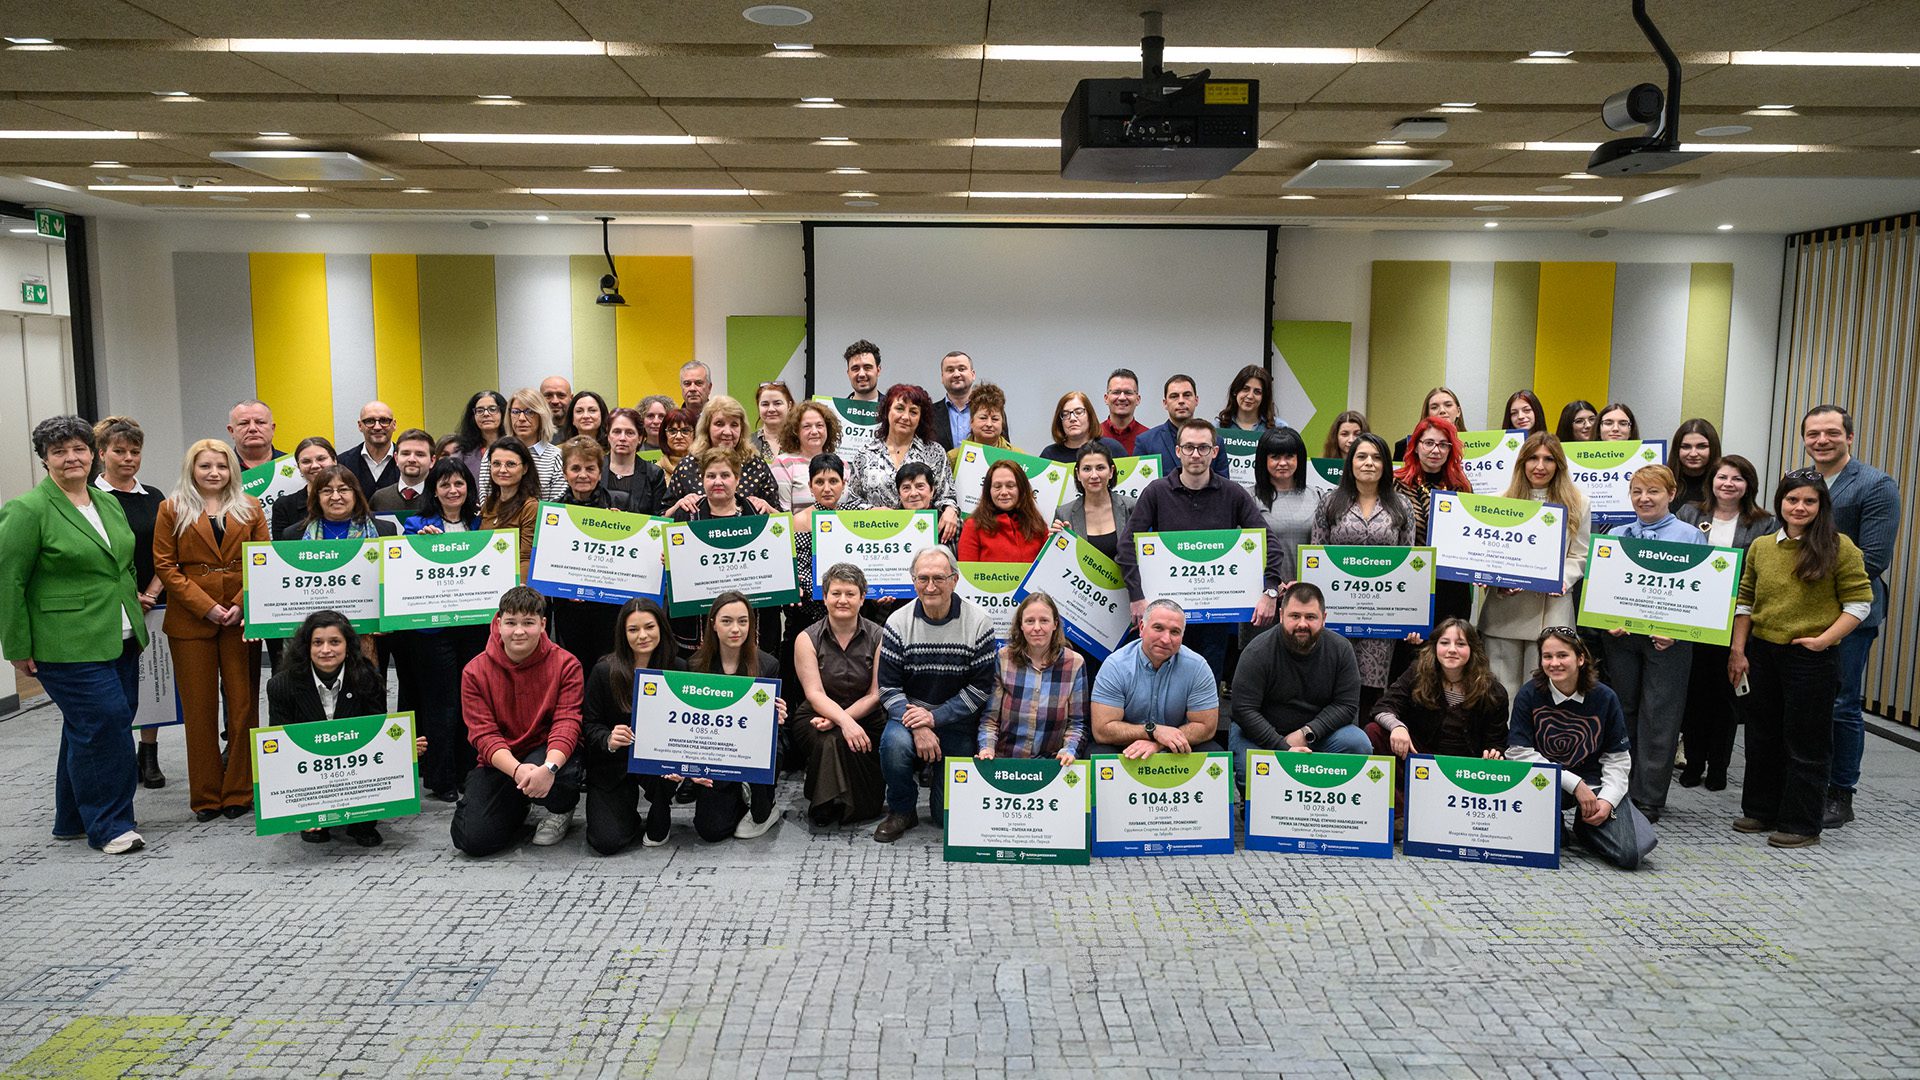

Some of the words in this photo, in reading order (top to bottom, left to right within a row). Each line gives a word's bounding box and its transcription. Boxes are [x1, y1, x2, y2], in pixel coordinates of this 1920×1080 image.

[847, 407, 879, 417] #BeLoca
[1576, 451, 1624, 459] #BeActive
[1228, 458, 1256, 469] 70.9
[1496, 460, 1504, 470] €
[1573, 471, 1619, 483] 766.94
[1623, 471, 1632, 481] €
[1474, 505, 1524, 518] #BeActive
[581, 518, 631, 532] #BeActive
[853, 520, 899, 528] #BeActive
[708, 526, 752, 538] #BeLocal
[1463, 526, 1470, 537] 2
[1475, 528, 1523, 543] 454.20
[1527, 534, 1537, 545] €
[431, 542, 470, 552] #BeFair
[571, 540, 580, 551] 3
[583, 542, 625, 557] 175.12
[629, 548, 639, 559] €
[845, 543, 853, 554] 6
[856, 543, 899, 554] 435.63
[903, 542, 912, 553] €
[1177, 541, 1224, 551] #BeGreen
[298, 551, 339, 560] #BeFair
[700, 555, 709, 566] 6
[712, 550, 756, 565] 237.76
[760, 549, 769, 560] €
[1342, 557, 1392, 566] #BeGreen
[1638, 549, 1690, 563] #BeVocal
[416, 569, 423, 580] 5
[428, 565, 477, 579] 884.97
[481, 565, 490, 576] €
[1083, 555, 1119, 585] #BeActive
[1170, 566, 1177, 577] 2
[1182, 564, 1225, 577] 224.12
[1229, 564, 1238, 575] €
[282, 577, 290, 589] 5
[295, 575, 346, 588] 879.86
[351, 574, 361, 585] €
[974, 573, 1019, 581] #BeActive
[1624, 573, 1633, 584] 3
[1637, 574, 1685, 590] 221.14
[1690, 580, 1701, 592] €
[1062, 568, 1072, 579] 7
[1070, 575, 1108, 606] 203.08
[1108, 603, 1118, 613] €
[1331, 581, 1339, 591] 6
[1344, 581, 1392, 592] 749.05
[1397, 581, 1406, 592] €
[682, 685, 733, 697] #BeGreen
[668, 711, 677, 723] 2
[682, 712, 733, 728] 088.63
[738, 717, 748, 729] €
[314, 730, 359, 744] #BeFair
[297, 761, 307, 774] 6
[313, 753, 368, 772] 881.99
[373, 751, 384, 764] €
[329, 771, 345, 779] 460
[994, 770, 1043, 781] #BeLocal
[1138, 765, 1189, 775] #BeActive
[1295, 764, 1347, 775] #BeGreen
[1455, 769, 1511, 782] #BeGreen
[982, 797, 990, 809] 5
[995, 798, 1044, 810] 376.23
[1048, 799, 1058, 811] €
[1128, 793, 1137, 805] 6
[1142, 792, 1189, 804] 104.83
[1194, 791, 1203, 803] €
[1284, 790, 1292, 801] 5
[1297, 791, 1346, 804] 152.80
[1351, 793, 1361, 805] €
[1448, 795, 1456, 808] 2
[1461, 797, 1506, 812] 518.11
[1512, 800, 1522, 813] €
